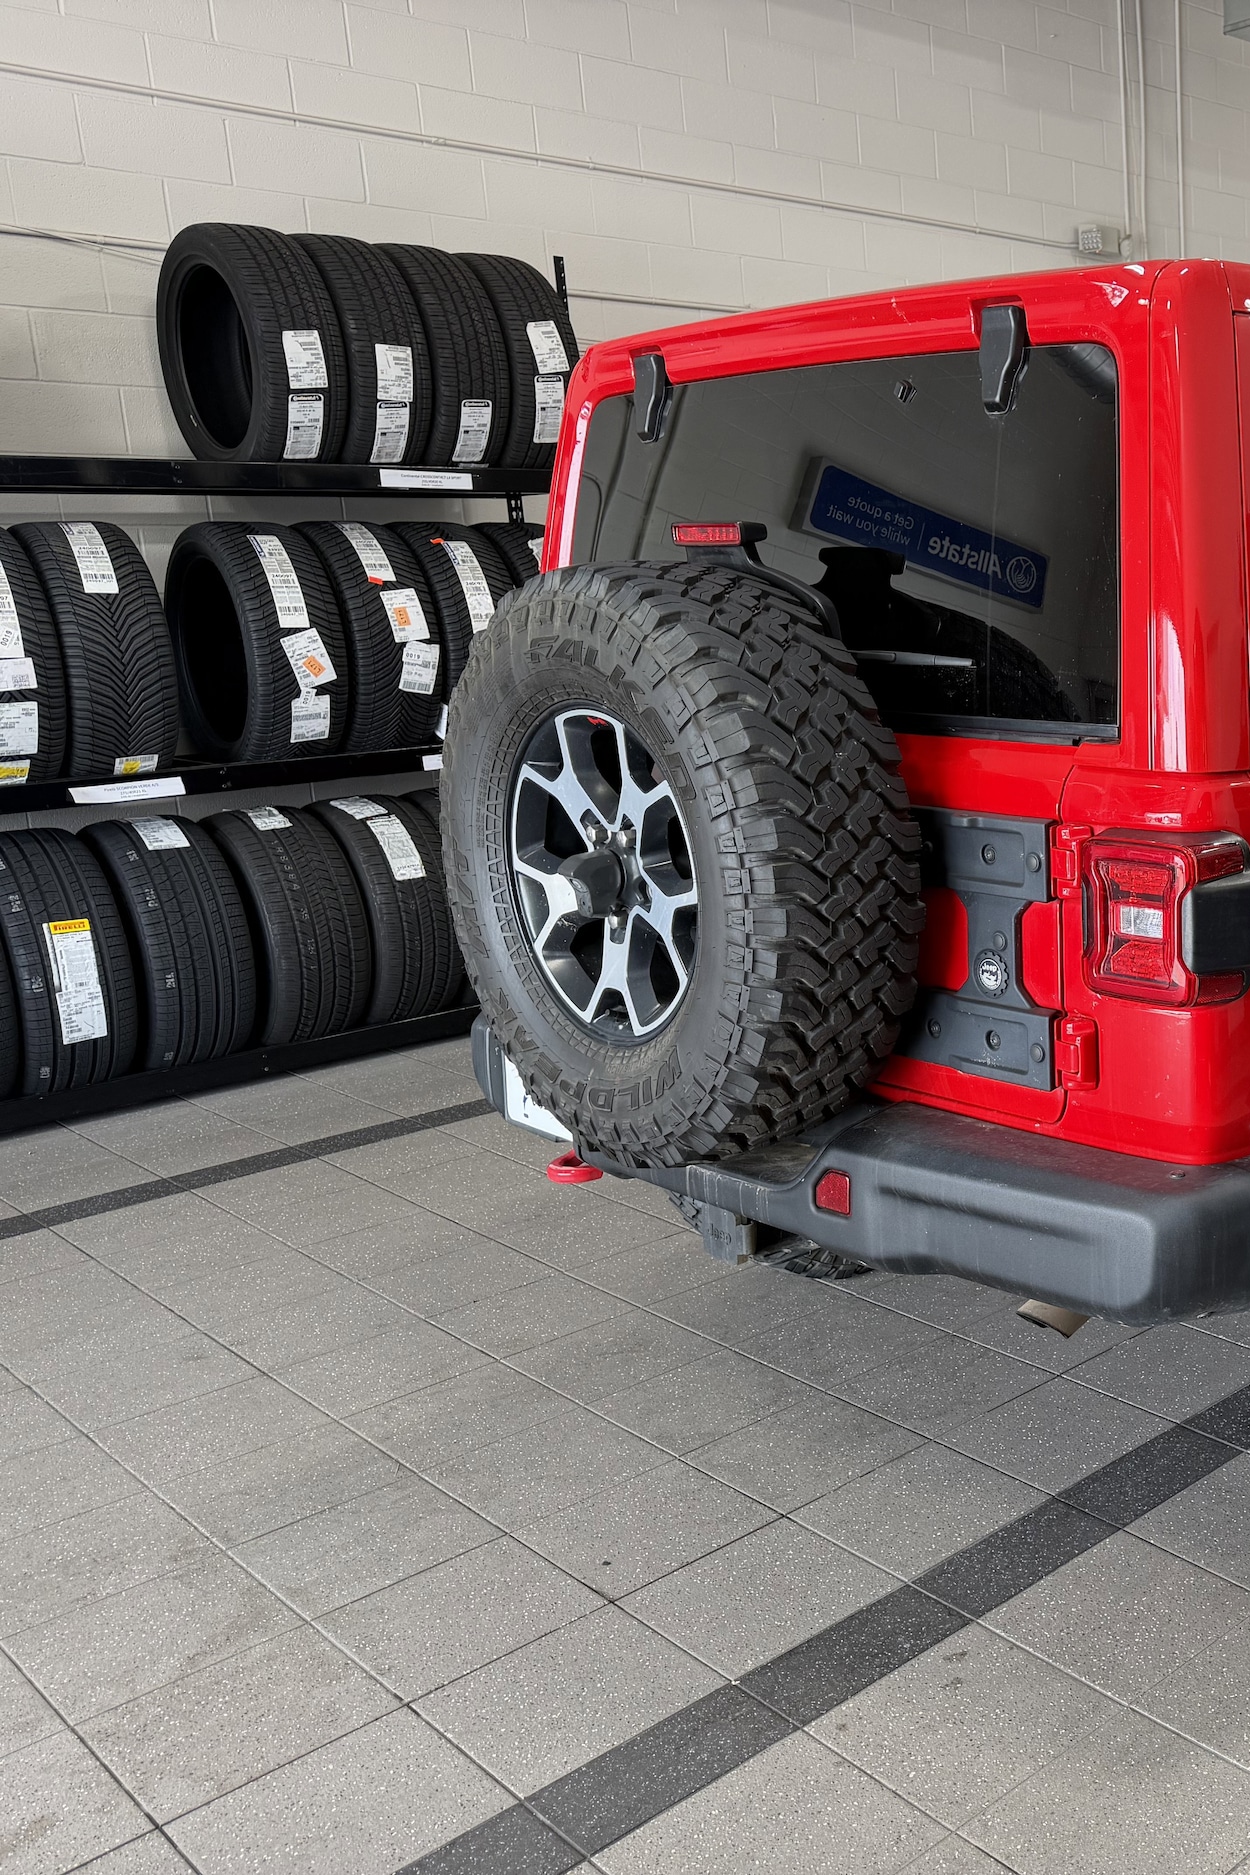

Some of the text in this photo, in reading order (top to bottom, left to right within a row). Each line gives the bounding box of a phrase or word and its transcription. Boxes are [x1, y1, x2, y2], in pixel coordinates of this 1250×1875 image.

[0, 629, 13, 647] 0019
[405, 652, 421, 660] 0019
[307, 660, 322, 674] L171
[302, 690, 311, 705] 0019
[524, 635, 698, 801] FALKEN
[53, 921, 86, 932] PIRELLI
[982, 962, 998, 973] Jeep
[489, 986, 683, 1112] WILDPEAK
